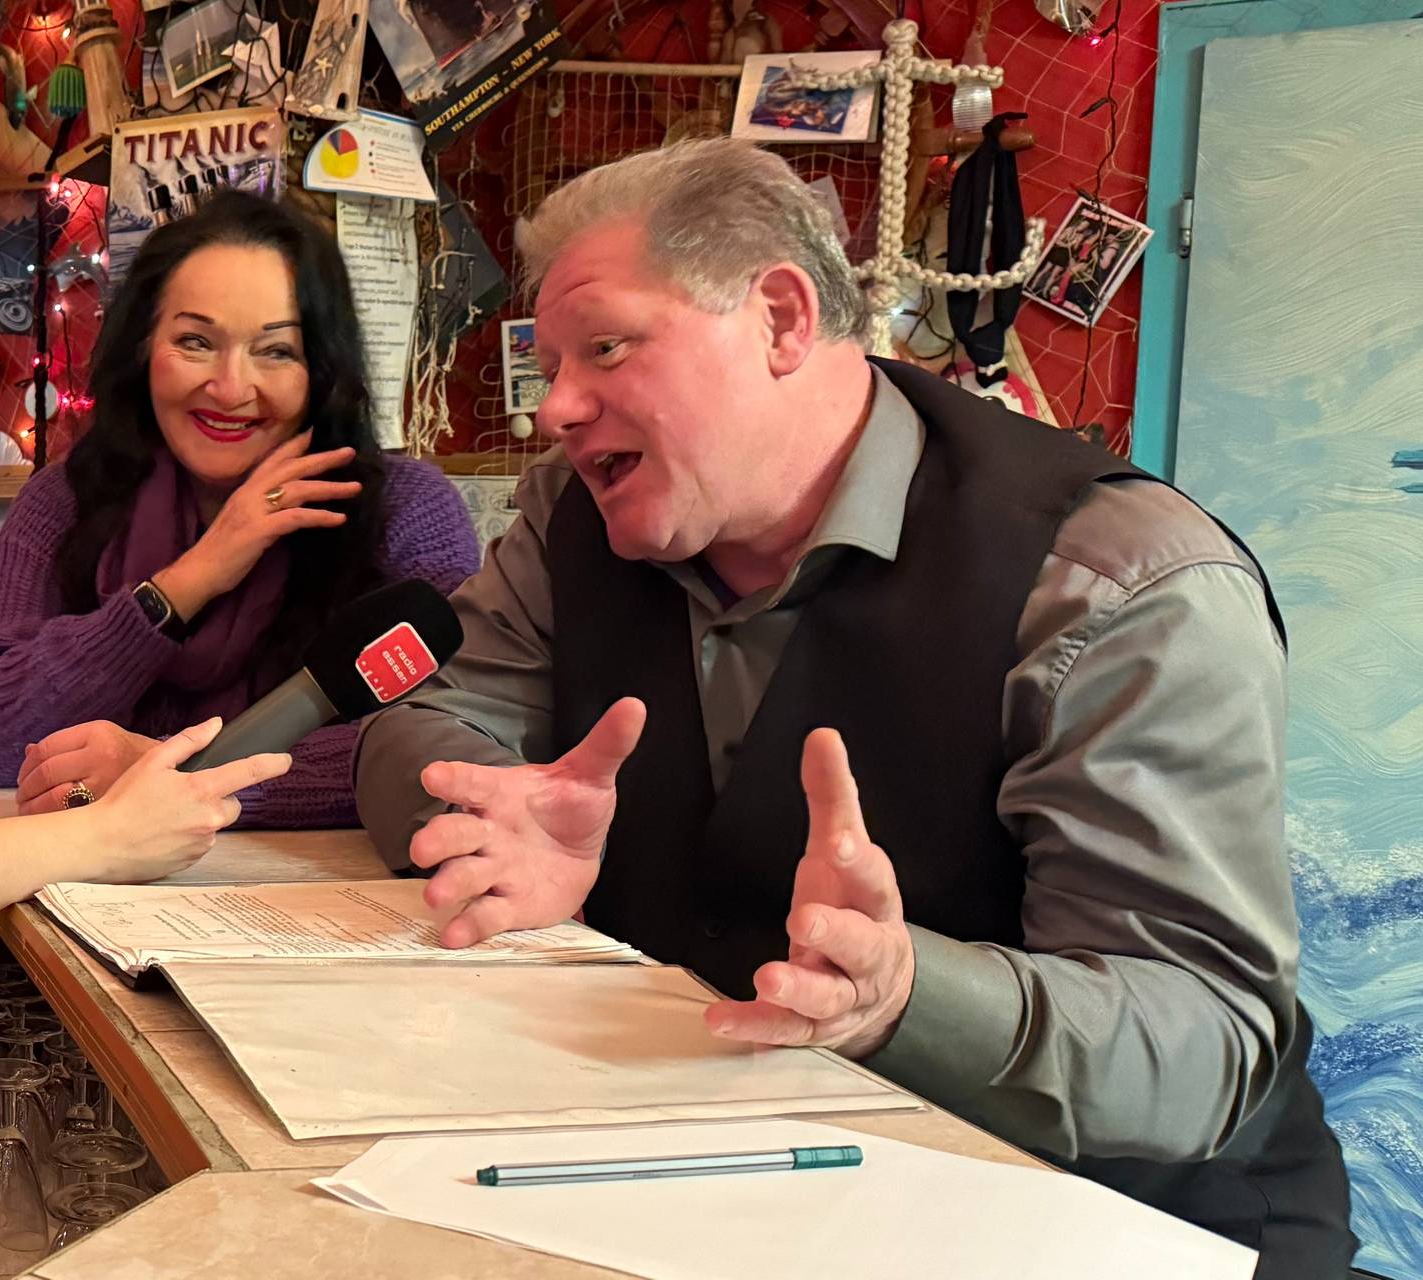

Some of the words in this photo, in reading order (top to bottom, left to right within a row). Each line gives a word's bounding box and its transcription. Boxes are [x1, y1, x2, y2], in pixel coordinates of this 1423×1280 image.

[425, 74, 500, 136] SOUTHAMPTON
[511, 48, 533, 70] NEW
[534, 27, 561, 51] YORK
[124, 121, 268, 164] TITANIC
[382, 650, 408, 684] essen
[394, 645, 417, 676] radio
